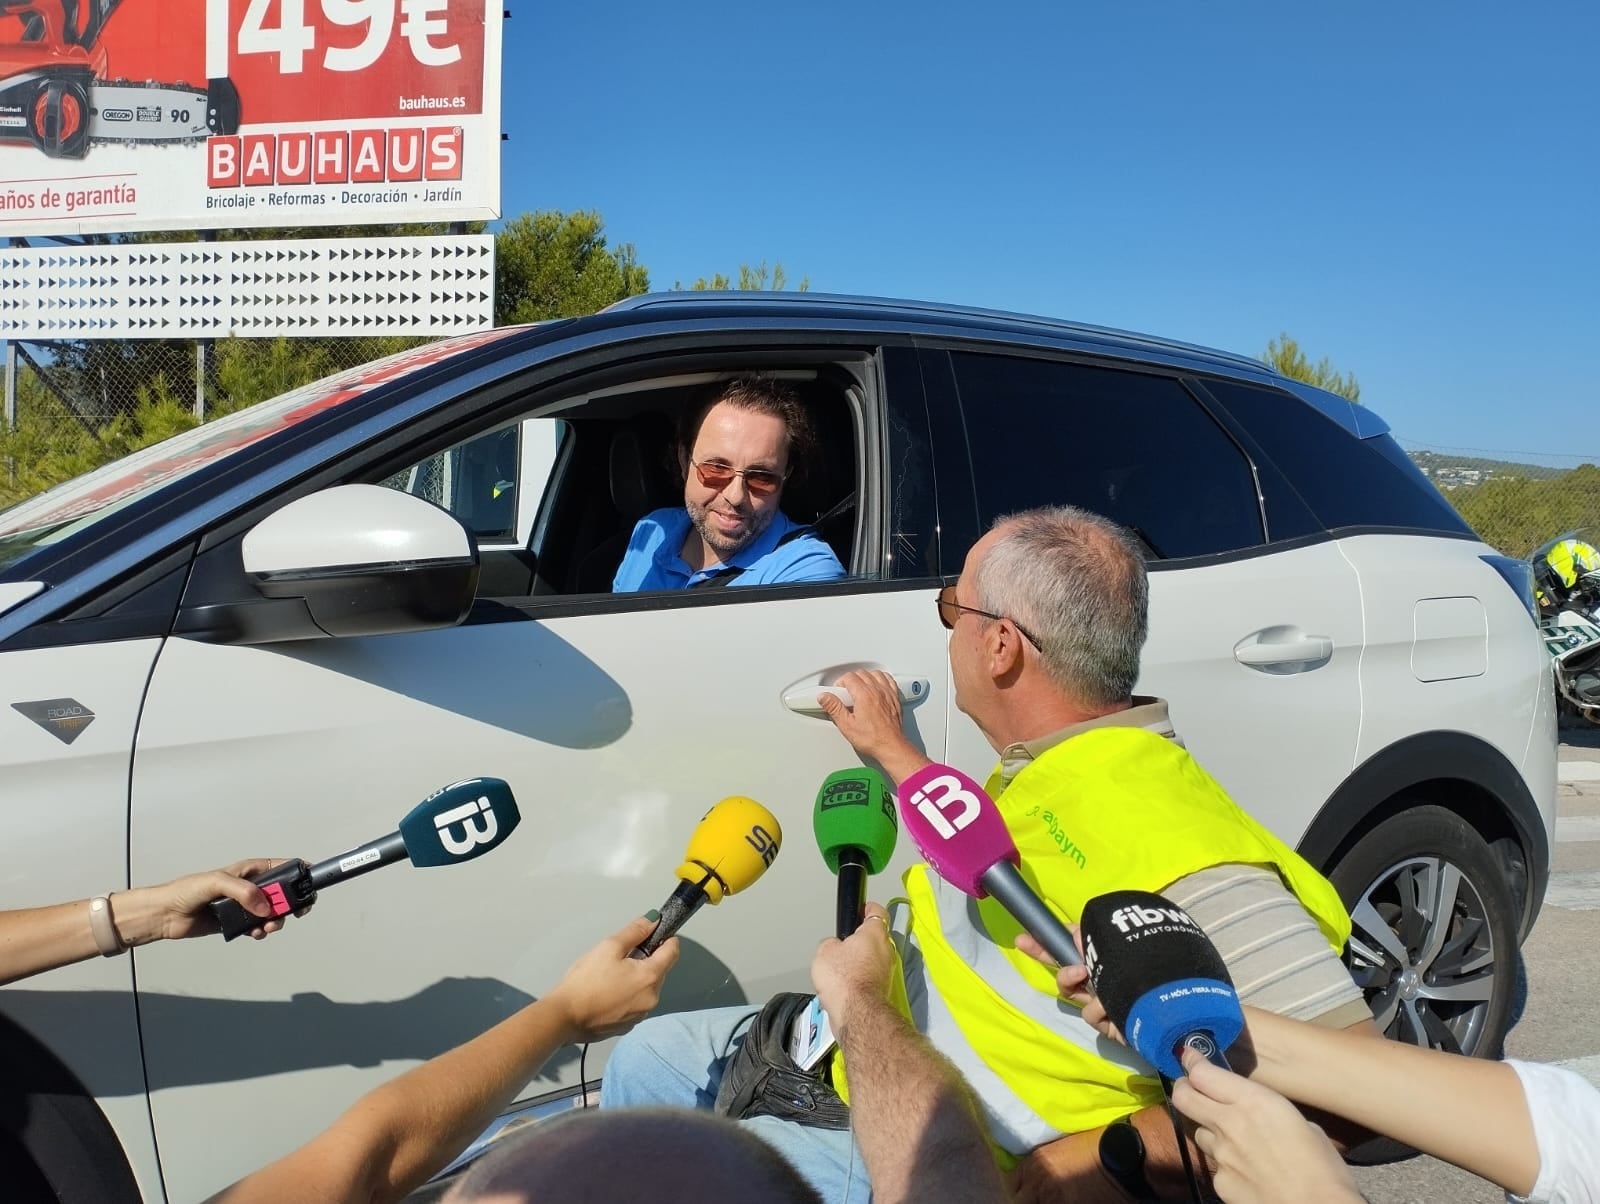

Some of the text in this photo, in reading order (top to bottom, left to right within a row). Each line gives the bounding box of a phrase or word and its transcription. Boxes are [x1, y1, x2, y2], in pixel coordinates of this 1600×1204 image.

[399, 95, 466, 110] bauhaus.es
[170, 109, 190, 123] 90
[212, 133, 458, 179] BAUHAUS
[0, 183, 136, 211] años de garantía
[206, 187, 462, 209] Bricolaje Reformas Decoración Jardín
[1126, 932, 1140, 943] TV
